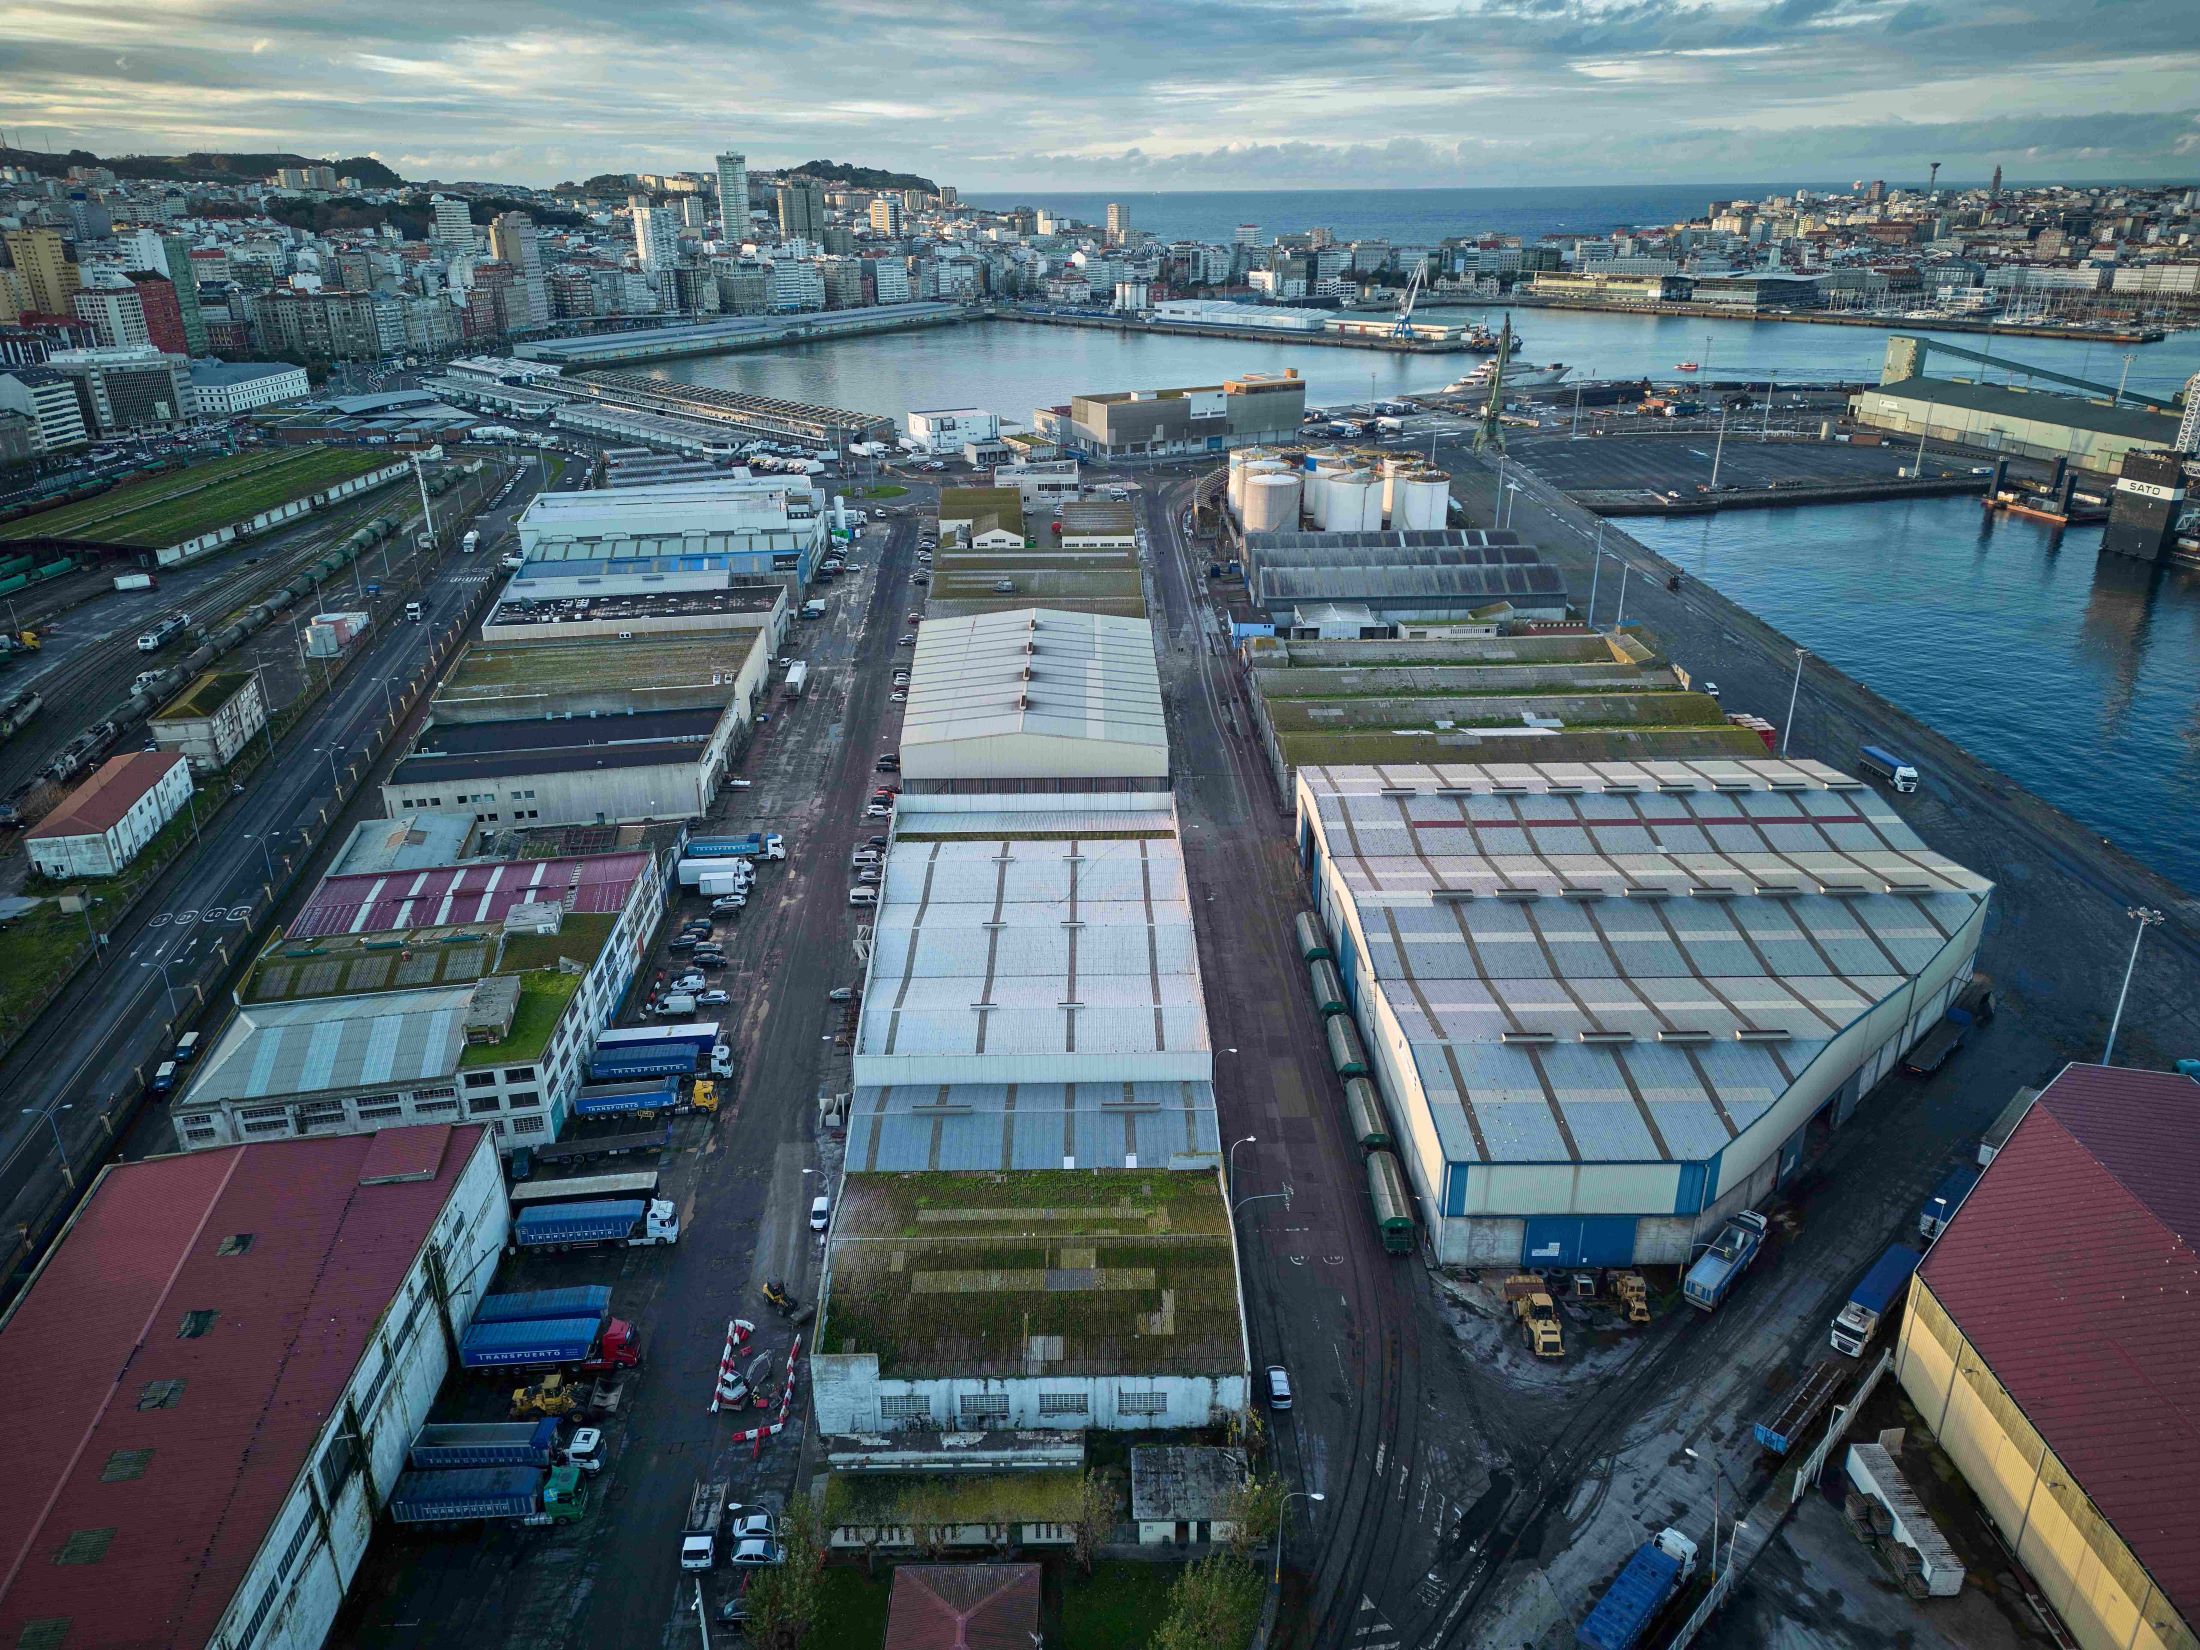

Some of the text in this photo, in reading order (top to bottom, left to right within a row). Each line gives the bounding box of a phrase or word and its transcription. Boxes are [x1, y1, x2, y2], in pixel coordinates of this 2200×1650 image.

[2129, 482, 2161, 496] SATO
[610, 1064, 683, 1074] TRANSPUERTO
[586, 1102, 639, 1112] TRANSPUERTO
[529, 1229, 613, 1240] TRANSPUERTO
[476, 1349, 561, 1361] TRANSPUERTO
[423, 1503, 509, 1515] TRANSPUERTO
